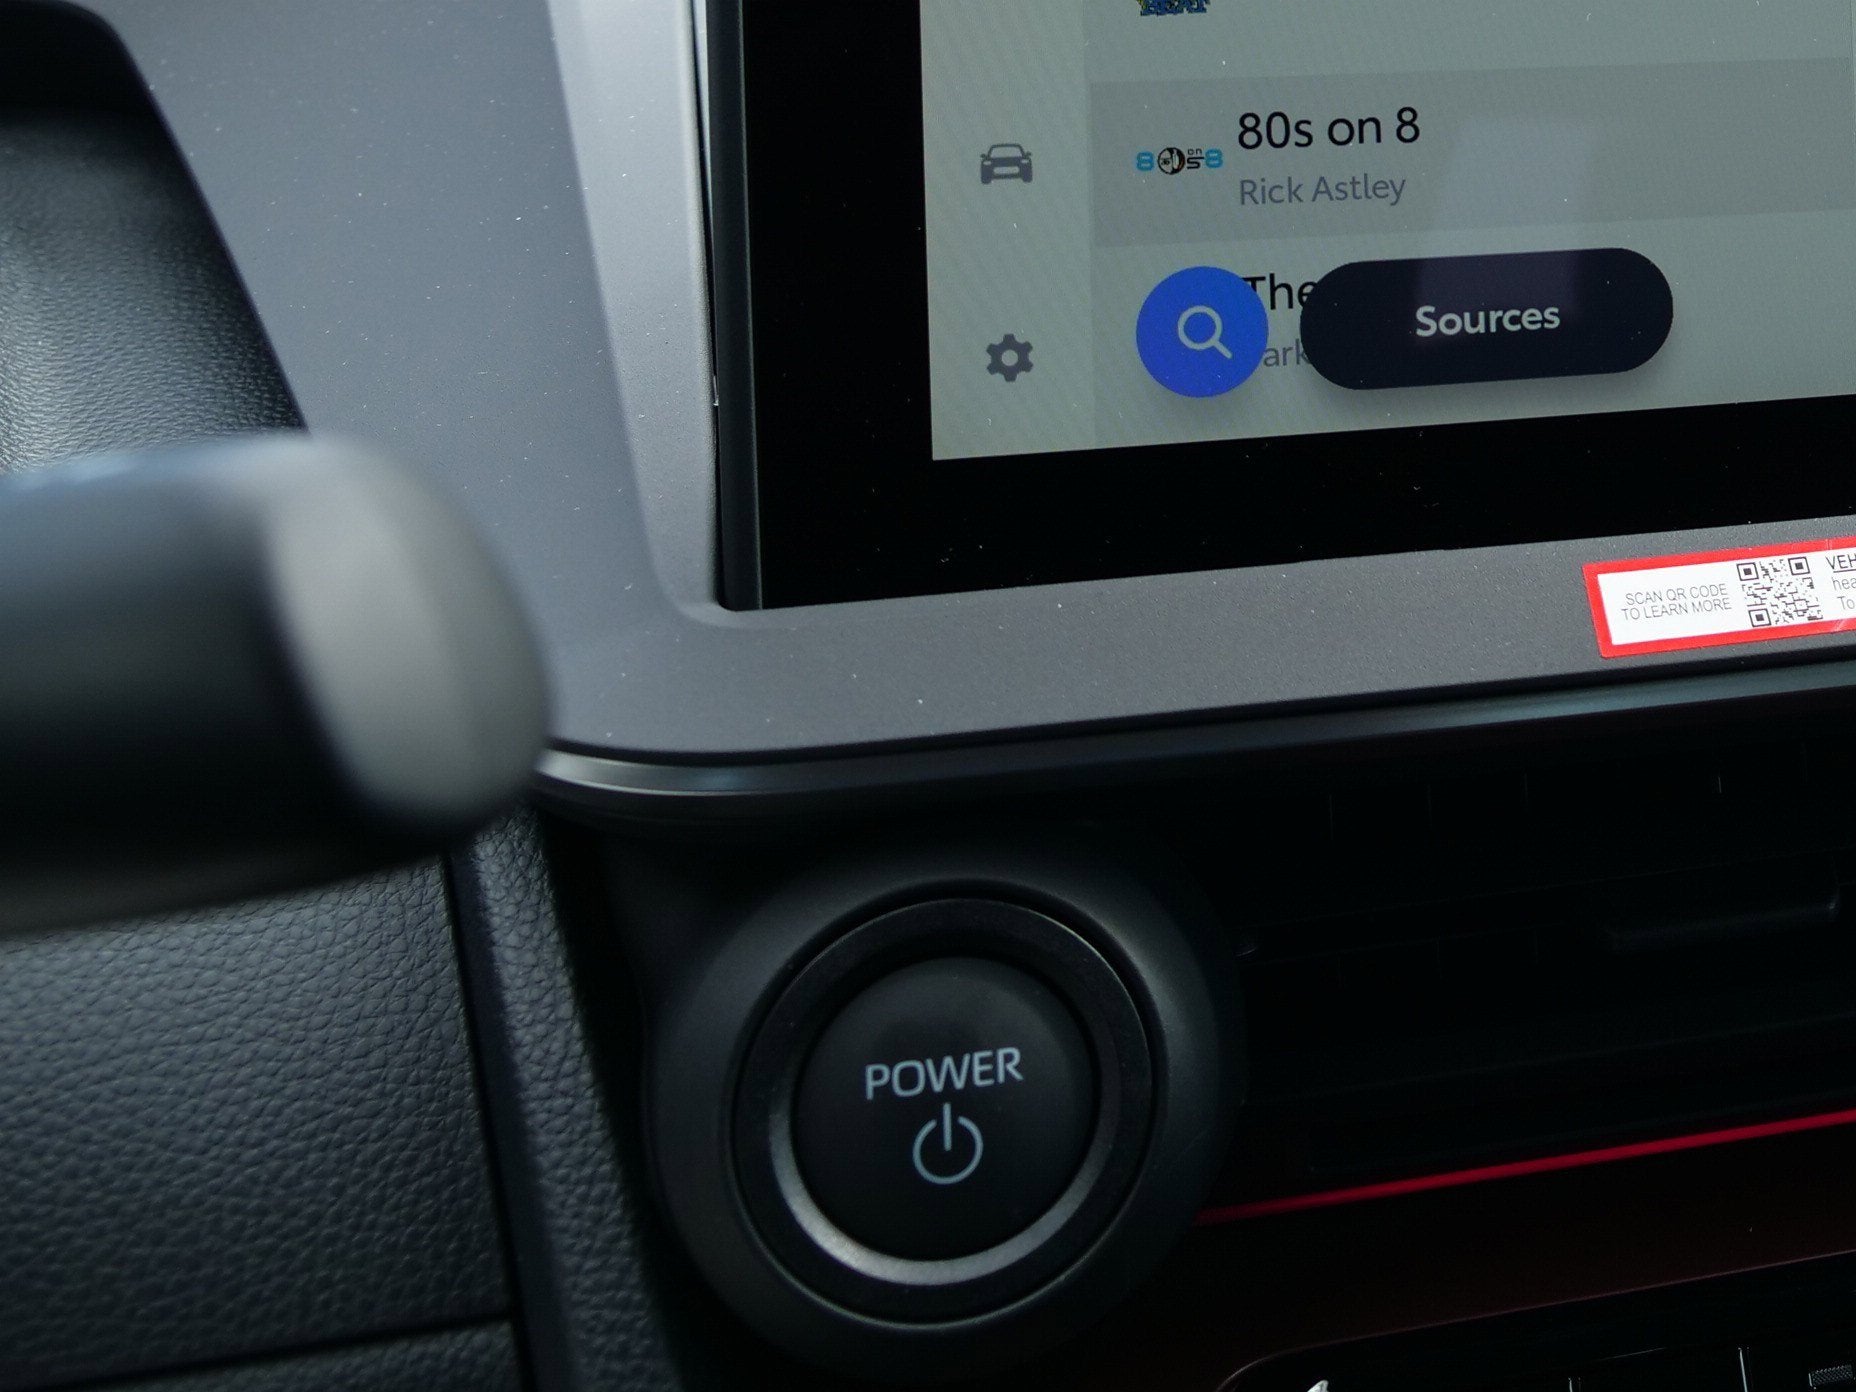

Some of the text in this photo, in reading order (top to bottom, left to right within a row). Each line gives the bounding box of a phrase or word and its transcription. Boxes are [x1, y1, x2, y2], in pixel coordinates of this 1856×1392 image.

[1237, 106, 1420, 149] 80s on 8
[1240, 172, 1406, 206] Rick Astley
[1415, 304, 1561, 337] Sources
[1263, 341, 1311, 368] ark
[1621, 597, 1732, 621] TO LEARN MORE
[1625, 583, 1728, 606] SCAN QR CODE
[1837, 595, 1856, 610] To
[865, 1046, 1025, 1101] POWER
